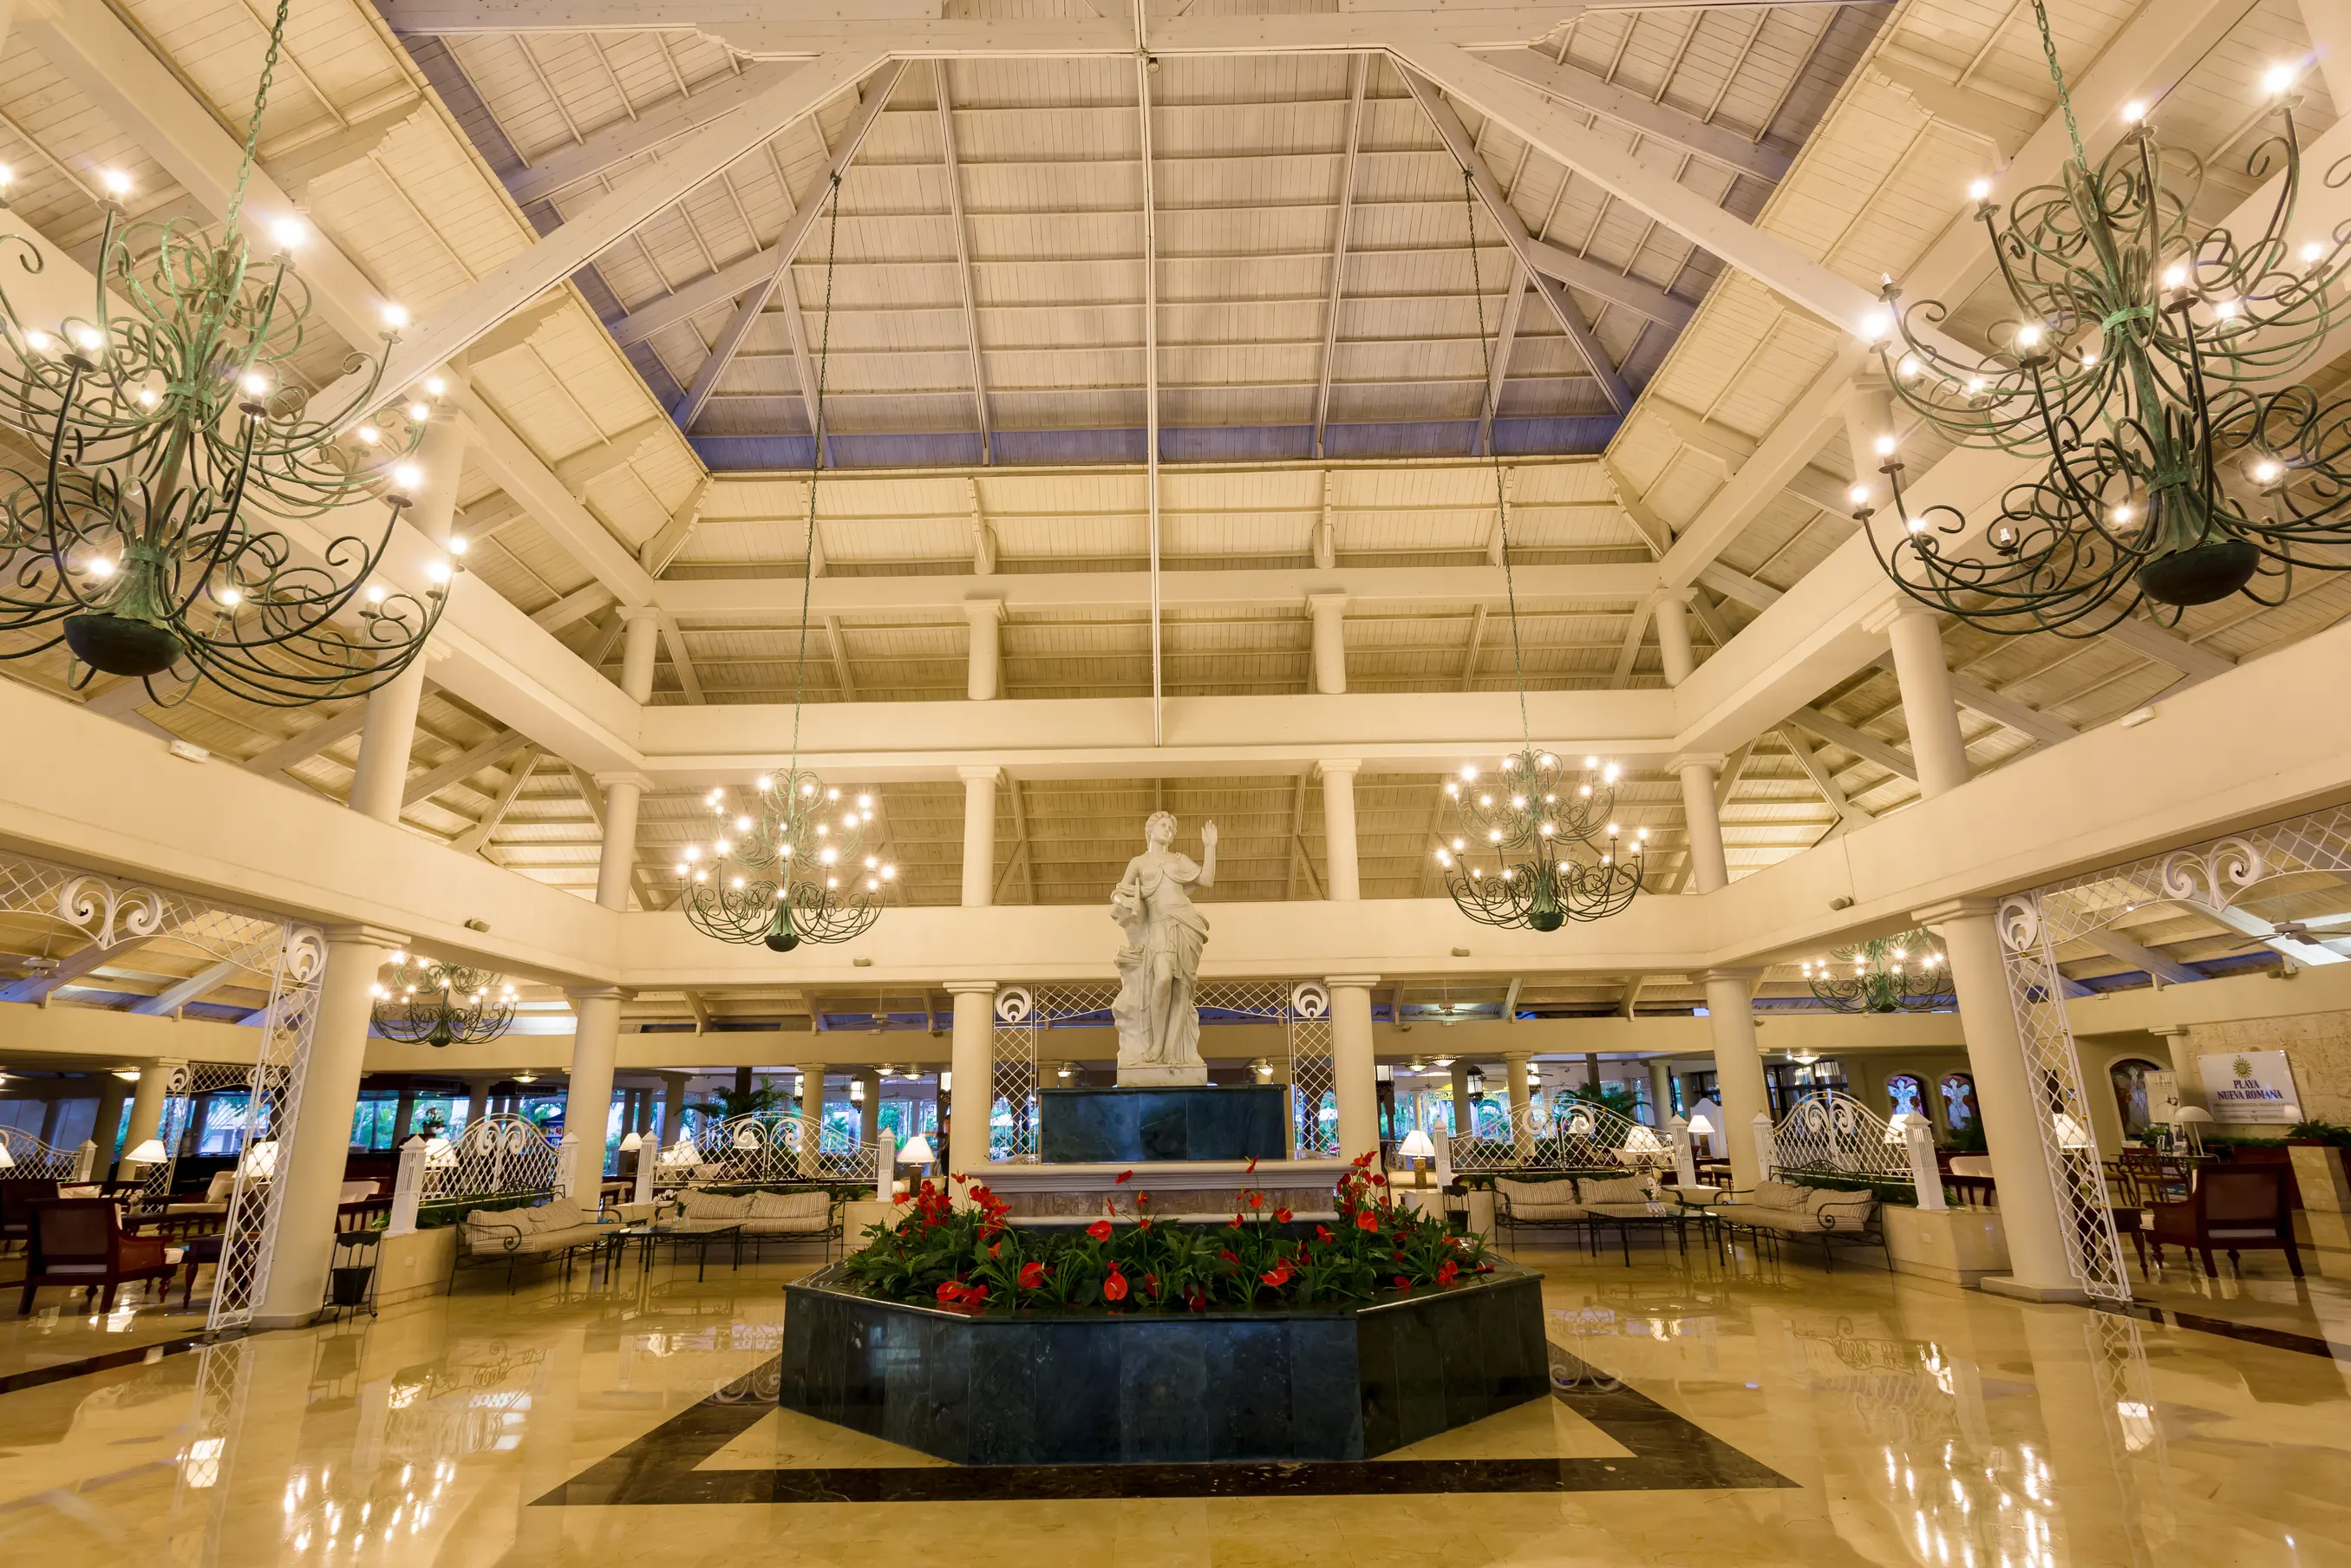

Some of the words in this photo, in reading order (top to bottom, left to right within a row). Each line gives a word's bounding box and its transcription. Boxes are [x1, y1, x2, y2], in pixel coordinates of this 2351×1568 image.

[2233, 1080, 2260, 1089] PLAYA
[2217, 1091, 2245, 1101] NUEVA
[2245, 1089, 2283, 1100] ROMANA
